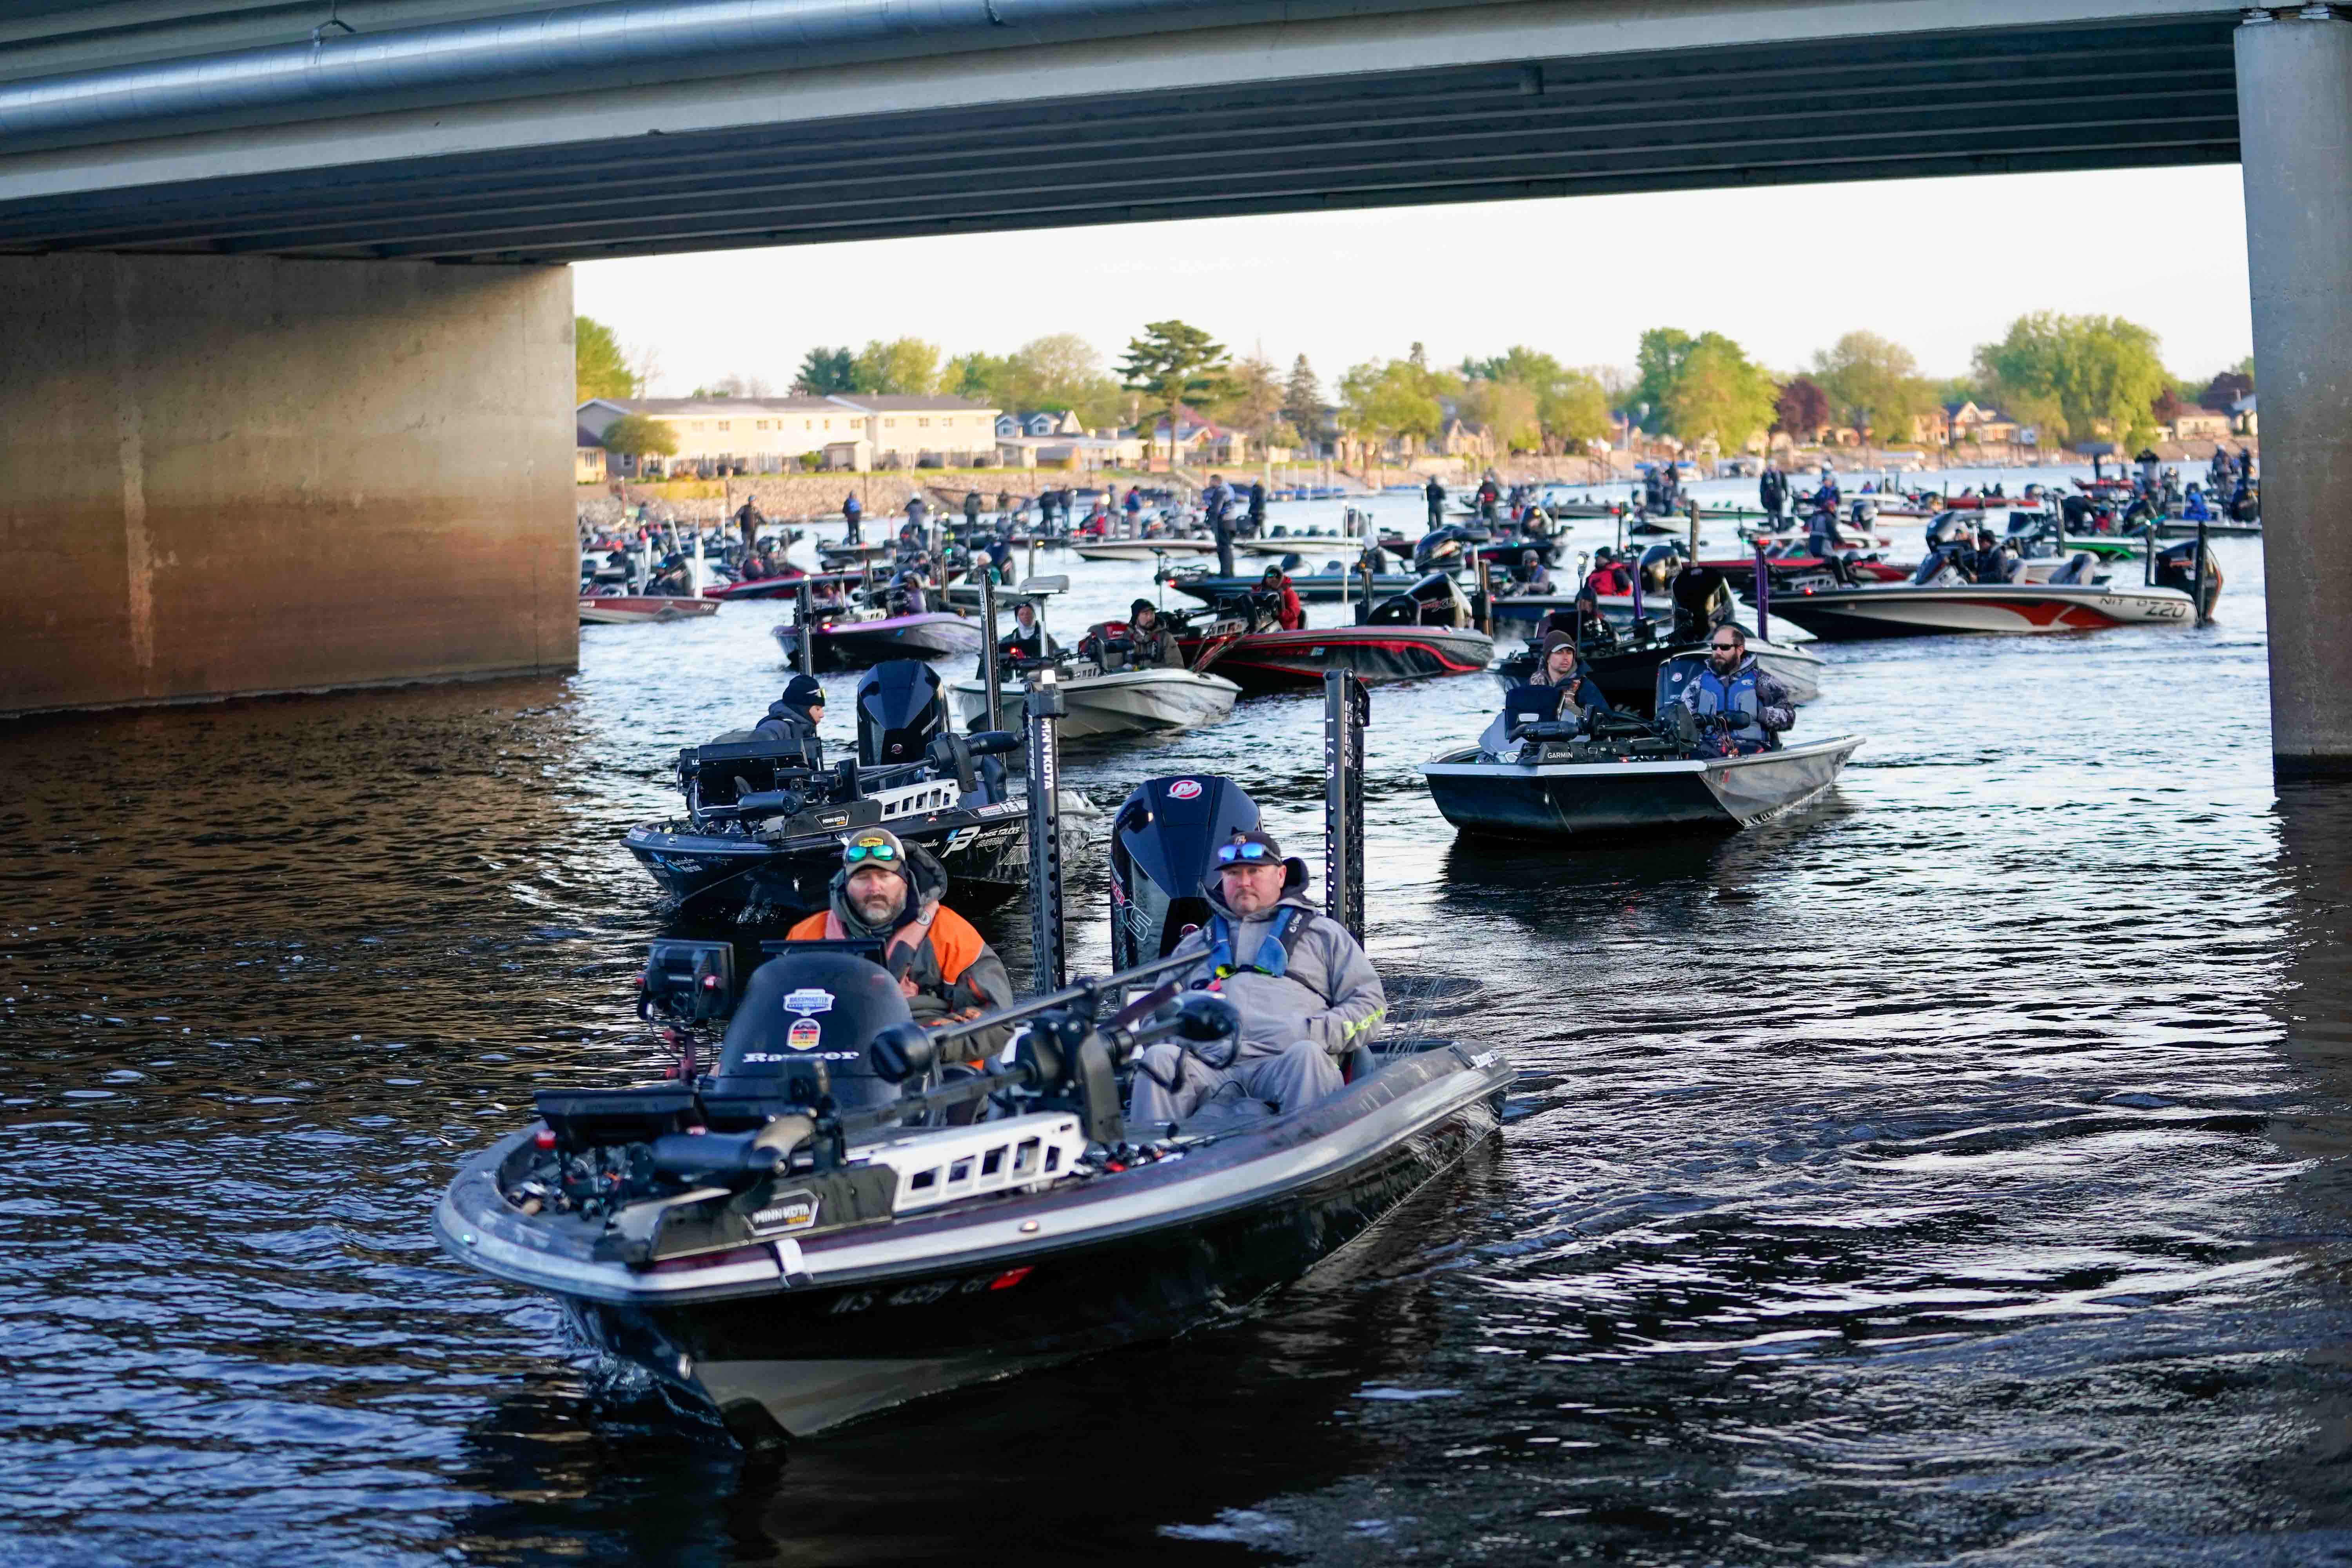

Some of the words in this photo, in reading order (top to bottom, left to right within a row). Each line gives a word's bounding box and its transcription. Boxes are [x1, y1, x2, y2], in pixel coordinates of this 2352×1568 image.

[2100, 597, 2147, 606] NITO
[2143, 601, 2187, 618] Z20
[1041, 717, 1052, 753] MINN
[1345, 700, 1353, 769] RAPTOR
[1043, 754, 1054, 790] KOTA
[753, 1208, 782, 1224] MINN
[783, 1203, 810, 1219] KOTA
